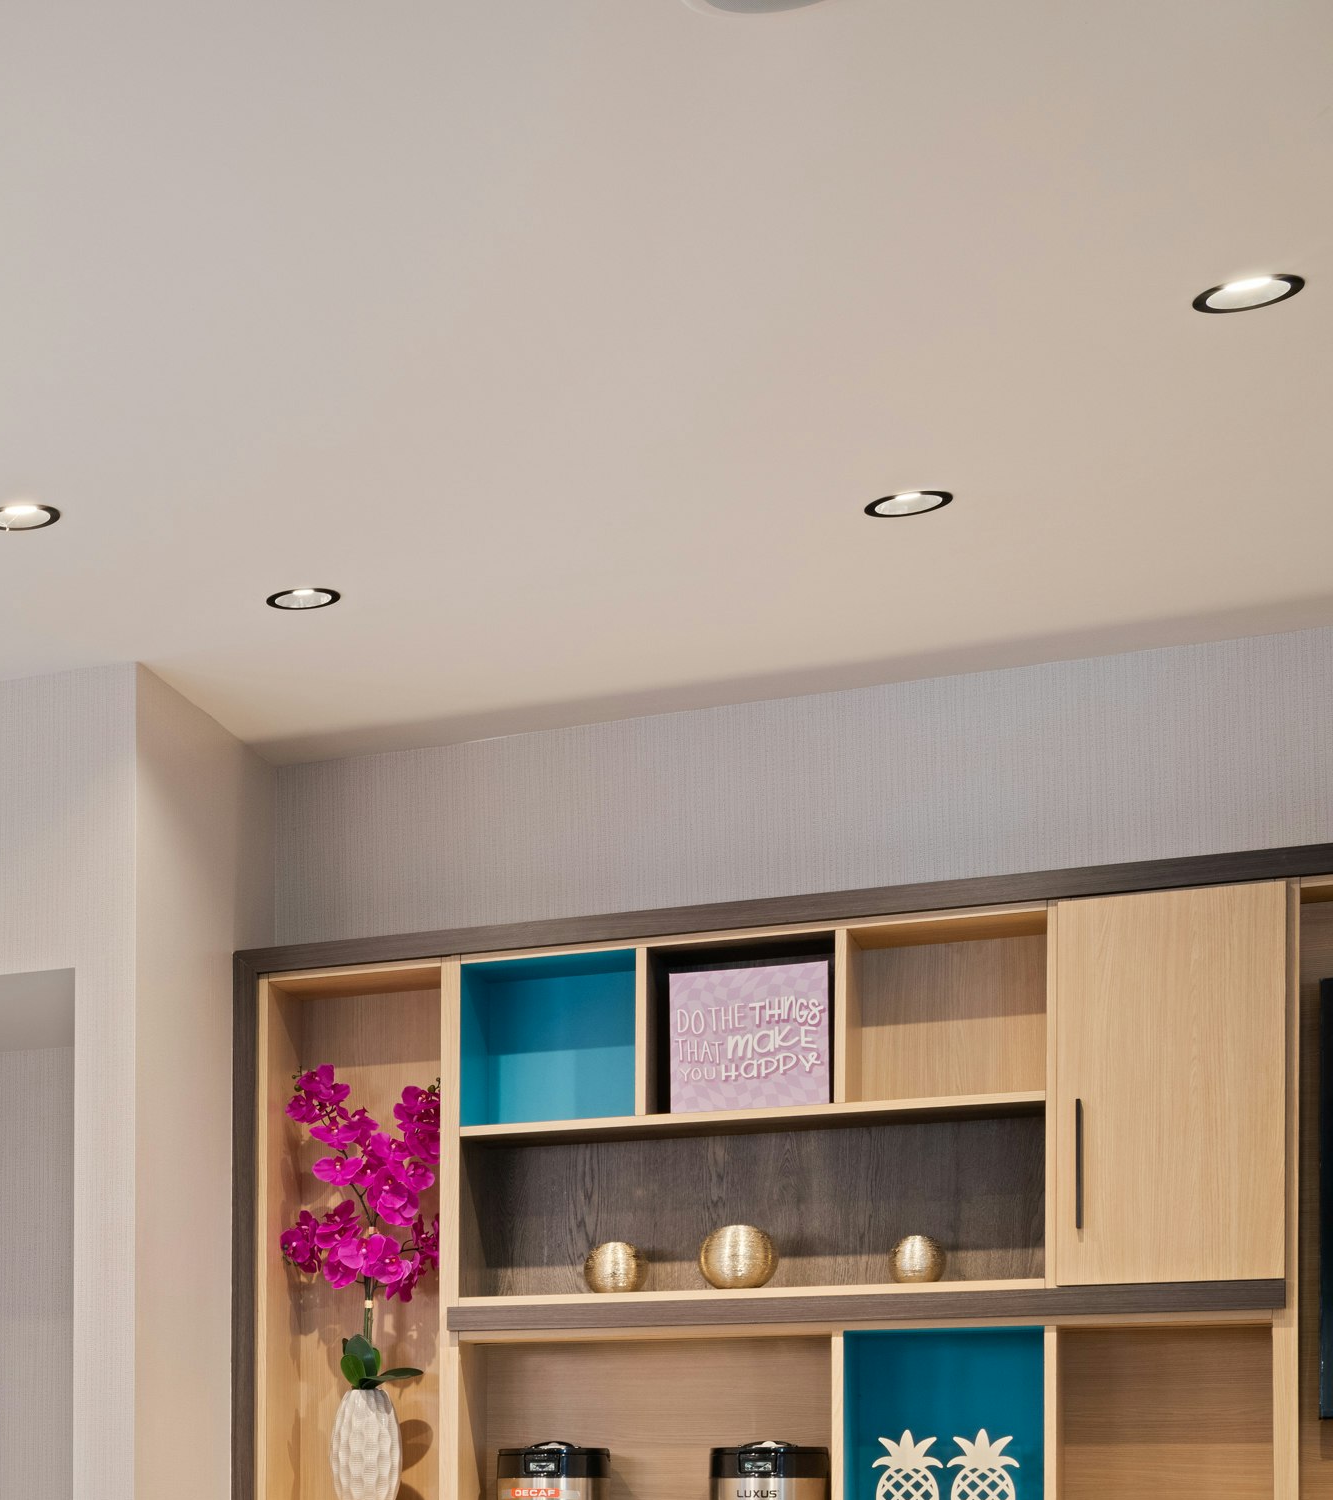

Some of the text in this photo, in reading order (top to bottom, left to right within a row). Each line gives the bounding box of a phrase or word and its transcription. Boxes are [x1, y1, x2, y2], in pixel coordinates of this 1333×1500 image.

[676, 1008, 706, 1035] DO
[708, 1003, 745, 1031] THE
[674, 1038, 724, 1064] THAT
[680, 1066, 717, 1082] YOU
[514, 1488, 557, 1498] DECAF
[736, 1489, 778, 1499] LUXUS
